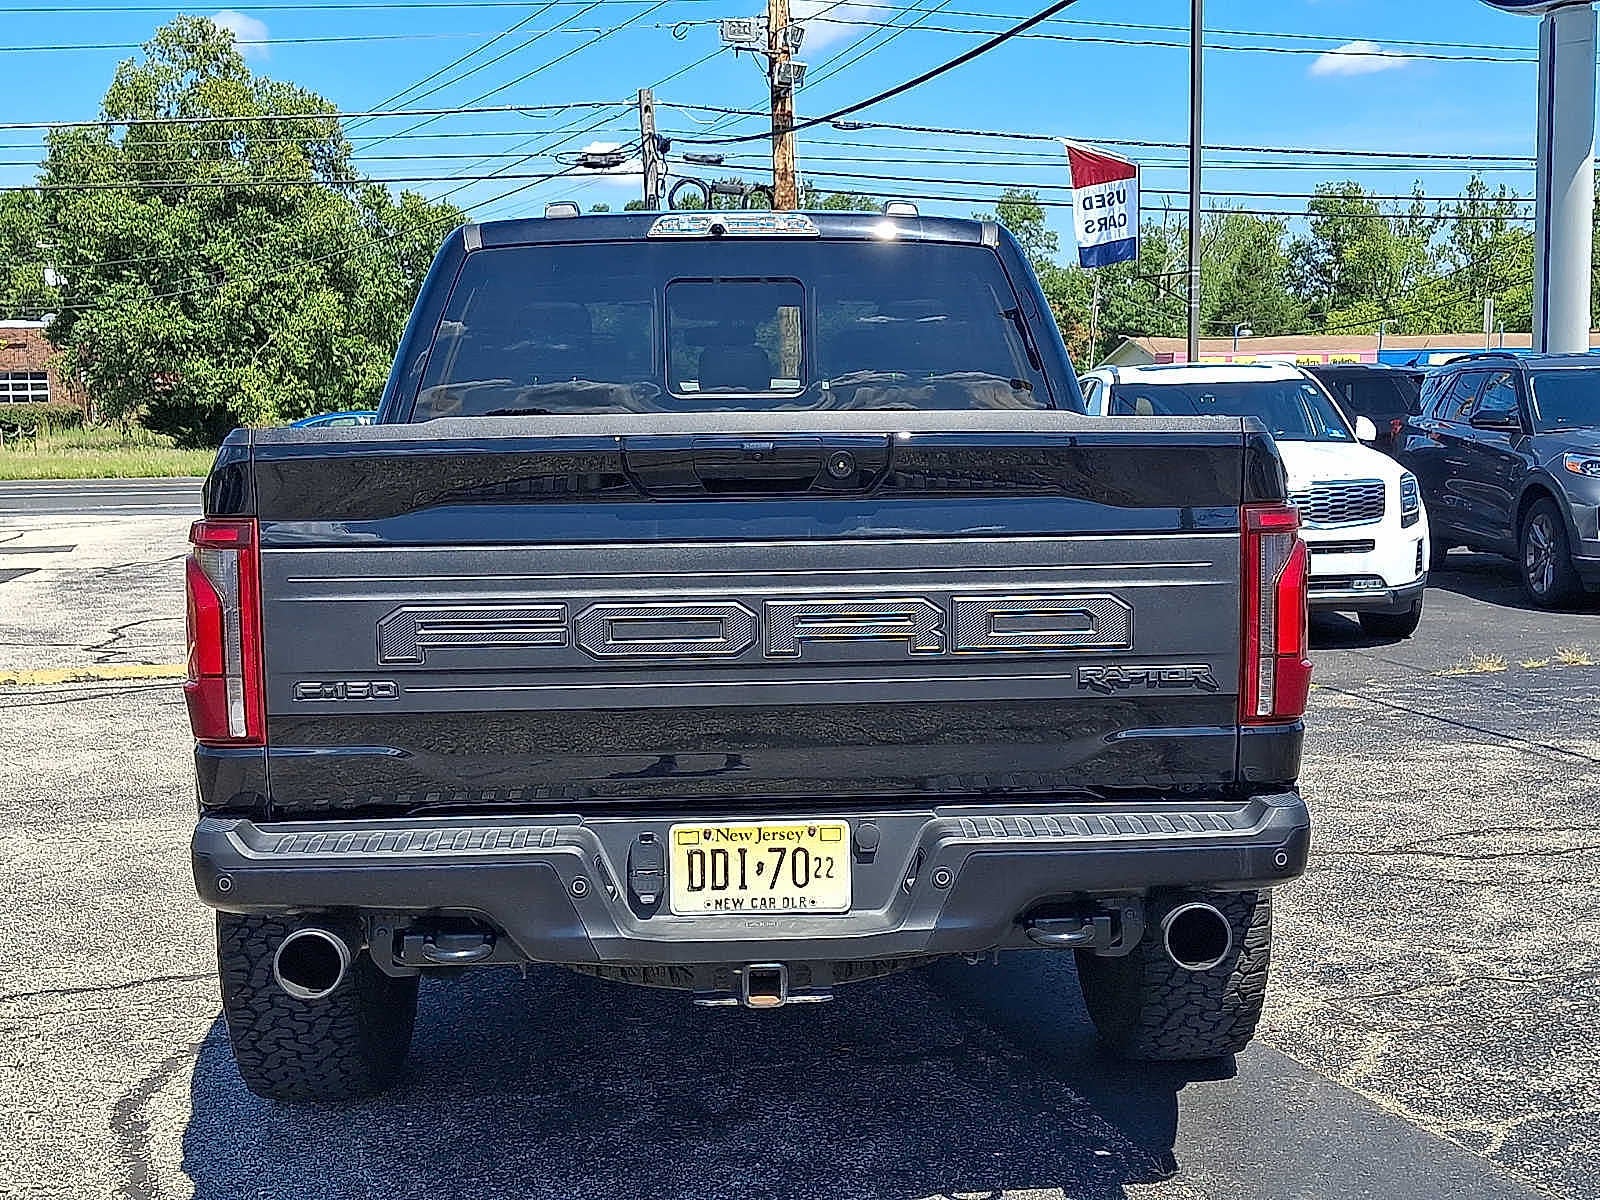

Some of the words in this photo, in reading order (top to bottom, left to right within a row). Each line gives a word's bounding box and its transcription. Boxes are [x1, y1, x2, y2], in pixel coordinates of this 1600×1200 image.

[376, 593, 1134, 665] FORD
[1077, 663, 1220, 695] RAPTOR
[715, 828, 751, 842] New
[755, 827, 804, 844] Jersey
[714, 897, 744, 910] NEW
[751, 897, 777, 909] CAR
[782, 896, 807, 909] DLR
